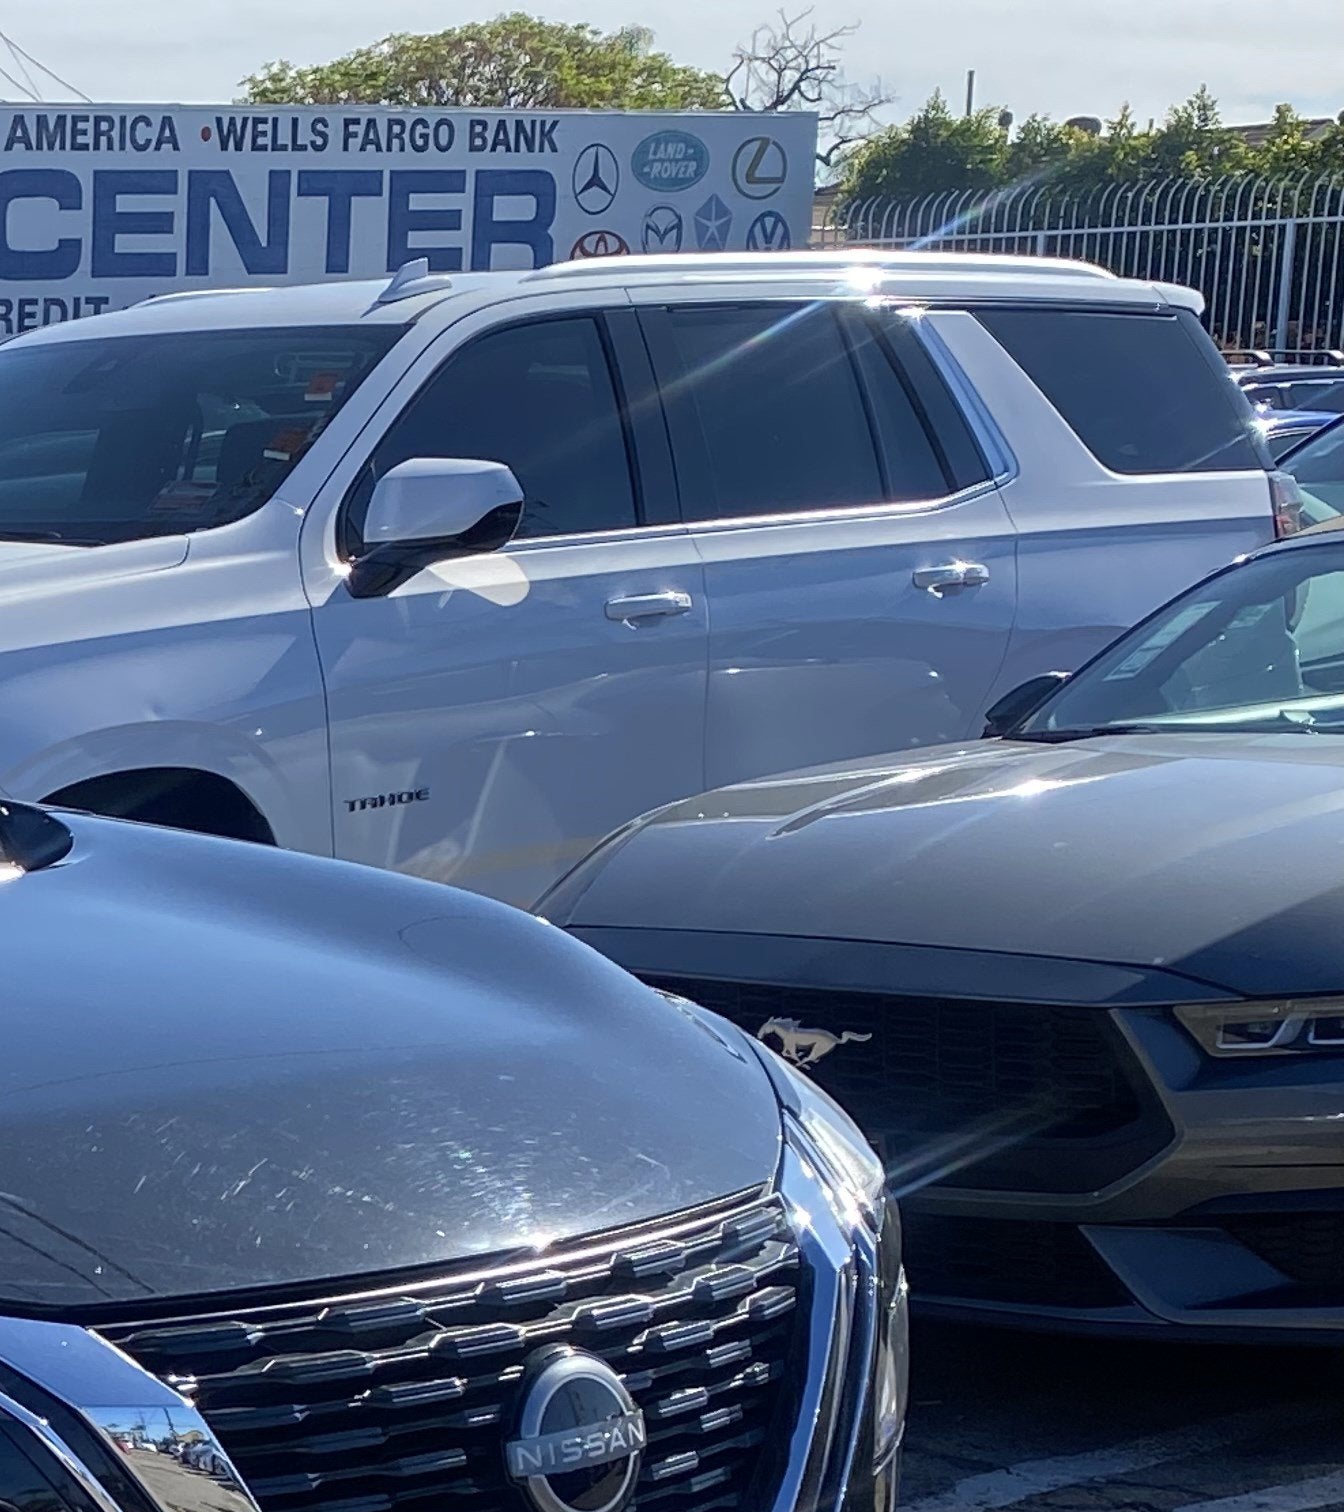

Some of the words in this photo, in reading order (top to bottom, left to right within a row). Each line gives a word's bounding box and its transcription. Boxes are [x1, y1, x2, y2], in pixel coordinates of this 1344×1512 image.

[4, 114, 181, 152] AMERICA
[216, 116, 329, 152] WELLS
[342, 117, 455, 152] FARGO
[469, 119, 559, 153] BANK
[343, 787, 431, 813] TAHOE
[516, 1417, 644, 1471] NISSAN
